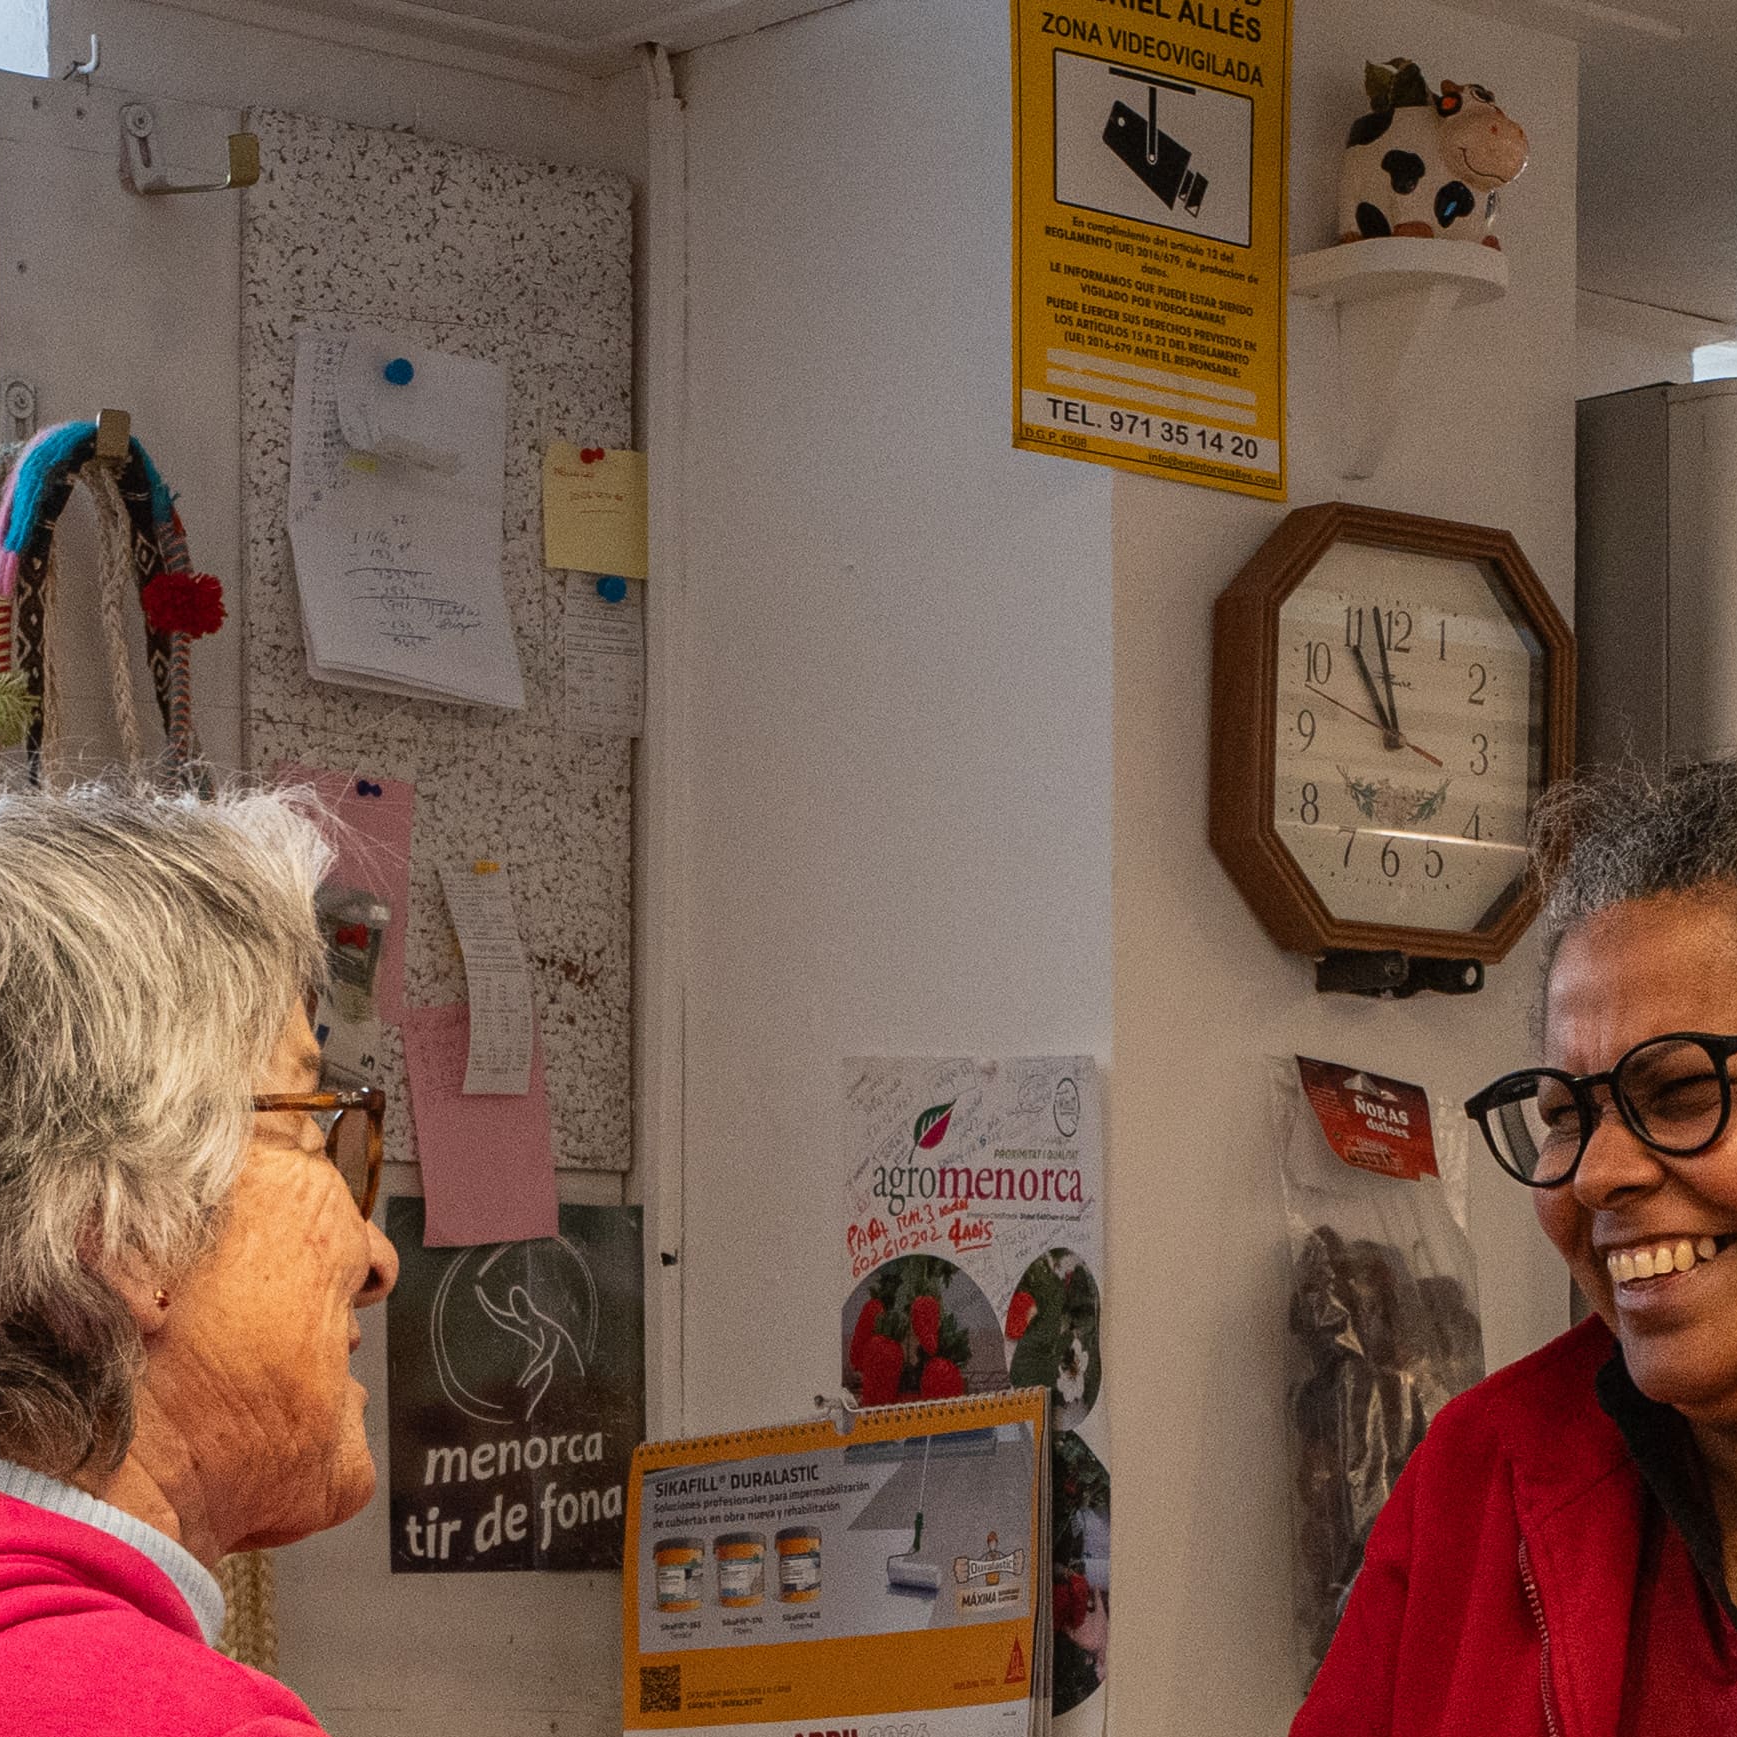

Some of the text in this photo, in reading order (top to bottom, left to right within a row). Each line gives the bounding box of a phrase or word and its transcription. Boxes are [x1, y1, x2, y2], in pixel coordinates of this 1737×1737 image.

[1178, 1, 1262, 43] ALLÉS
[1041, 12, 1264, 87] ZONA VIDEOVIGILADA
[1045, 225, 1112, 249] REGLAMENTO
[1114, 241, 1135, 257] (UE)
[1186, 256, 1198, 269] de
[1072, 217, 1084, 228] En
[1087, 221, 1151, 244] cumplimiento
[1153, 231, 1168, 247] del
[1206, 245, 1218, 259] 12
[1220, 250, 1234, 263] del
[1049, 262, 1253, 317] LE INFORMAMOS QUE PUEDE ESTAR SIENDO
[1080, 282, 1129, 303] VIGILADO
[1131, 295, 1151, 308] POR
[1046, 295, 1078, 313] PUEDE
[1082, 303, 1119, 322] EJERCER
[1123, 312, 1141, 326] SUS
[1143, 317, 1192, 338] DERECHOS
[1194, 328, 1242, 350] PREVISTOS
[1054, 313, 1073, 326] LOS
[1131, 330, 1143, 341] 15
[1145, 333, 1153, 343] A
[1154, 335, 1166, 346] 22
[1168, 338, 1187, 351] DEL
[1189, 342, 1249, 365] REGLAMENTO
[1135, 347, 1160, 360] ANTE
[1162, 352, 1173, 363] EL
[1174, 355, 1241, 378] RESPONSABLE:
[1047, 398, 1258, 459] TEL. 971 35 14 20
[1385, 610, 1413, 653] 12
[1438, 620, 1446, 661] 1
[1305, 642, 1332, 684] 10
[1469, 664, 1487, 705] 2
[1297, 710, 1488, 776] 9 3
[1301, 783, 1481, 842] 8 4
[1338, 831, 1443, 878] 7 6 5
[1365, 1118, 1410, 1139] dulces
[872, 1165, 1084, 1217] agromenorca
[424, 1431, 603, 1485] menorca
[731, 1464, 819, 1491] DURALASTIC
[652, 1501, 841, 1530] de cubiertas en obra nueva y rehabilitación
[653, 1480, 870, 1514] Soluciones profesionales para impermeabilización
[405, 1482, 622, 1560] tir de fona
[970, 1557, 1014, 1575] Duralastic
[961, 1590, 997, 1607] MÁXIMA
